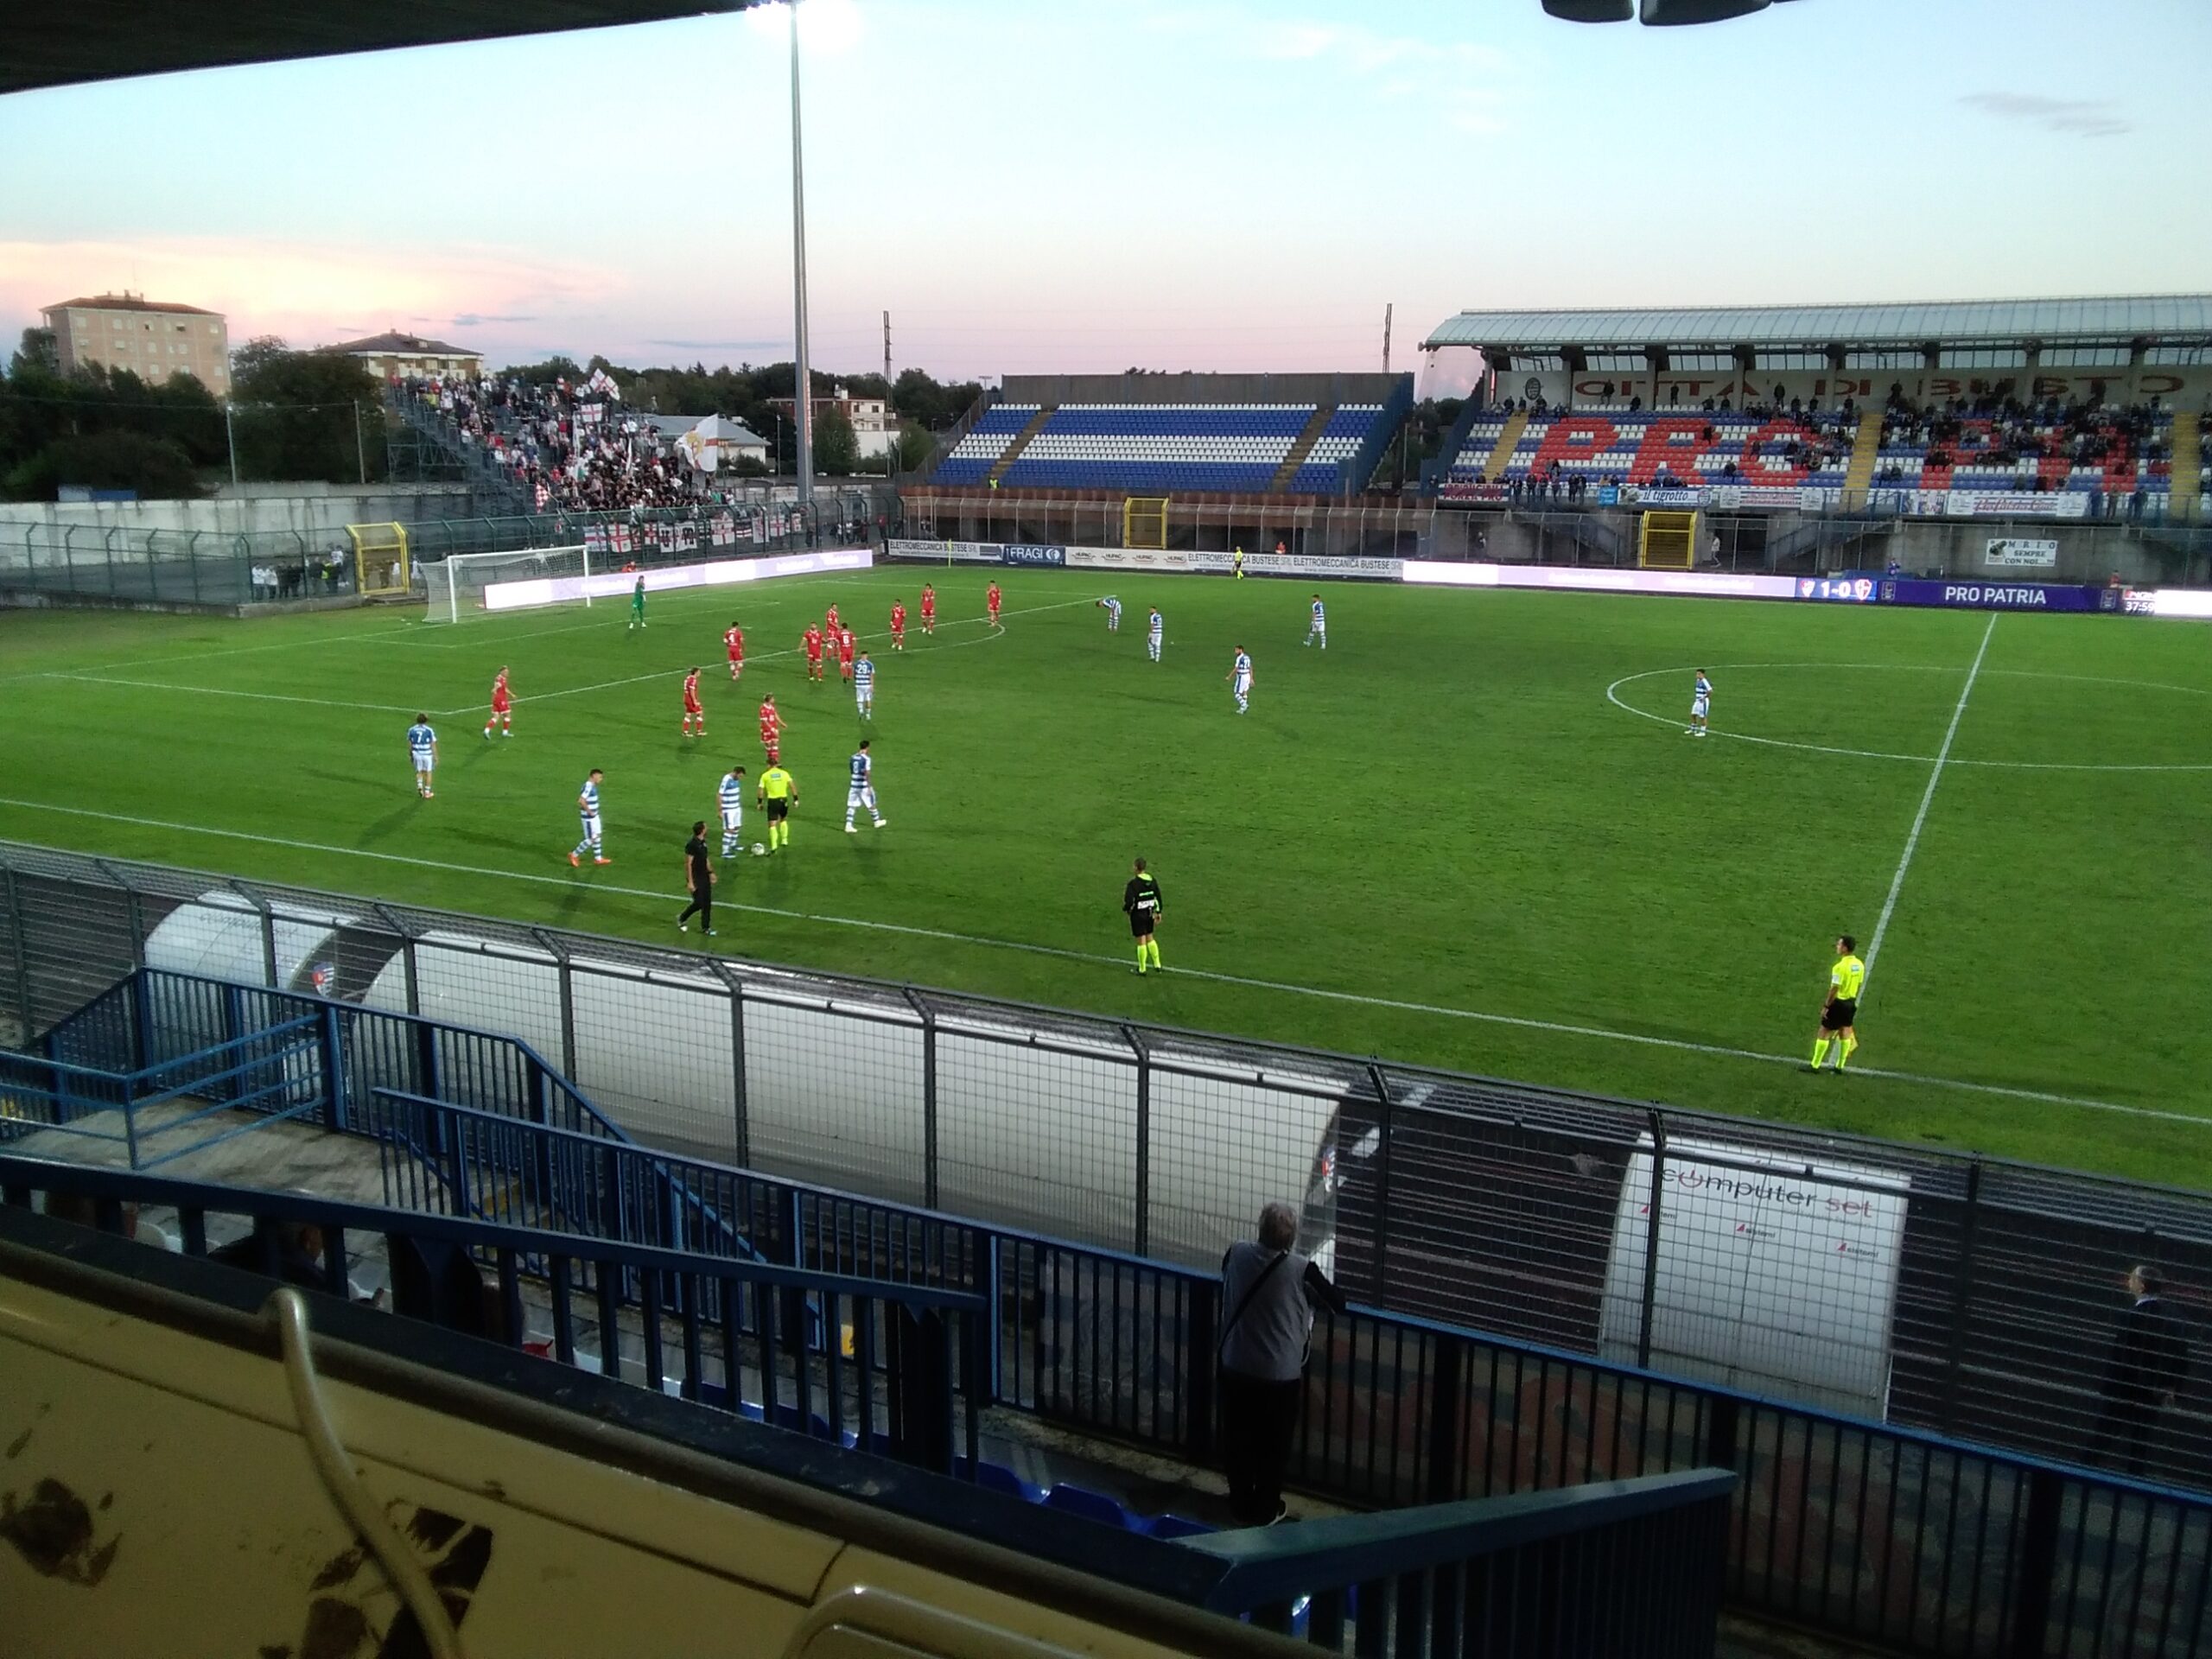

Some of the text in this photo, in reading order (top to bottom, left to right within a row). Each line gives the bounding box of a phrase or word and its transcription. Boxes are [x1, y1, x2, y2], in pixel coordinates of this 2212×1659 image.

[1815, 378, 1872, 397] DI
[1643, 488, 1688, 503] il tigrotto
[1010, 548, 1043, 560] FRAGI
[1188, 553, 1250, 564] ELETTROMECCACA
[1251, 556, 1280, 565] BUSTESE
[1294, 557, 1359, 568] ELETTROMECCANICA
[1361, 560, 1390, 569] BUSTESE
[1821, 581, 1851, 597] 1-0
[1945, 586, 2046, 604] PRO PATRIA
[2125, 601, 2154, 612] 37:59
[857, 664, 868, 674] 29
[416, 731, 423, 743] 7
[1662, 1168, 1817, 1207] computer
[1825, 1197, 1872, 1218] set
